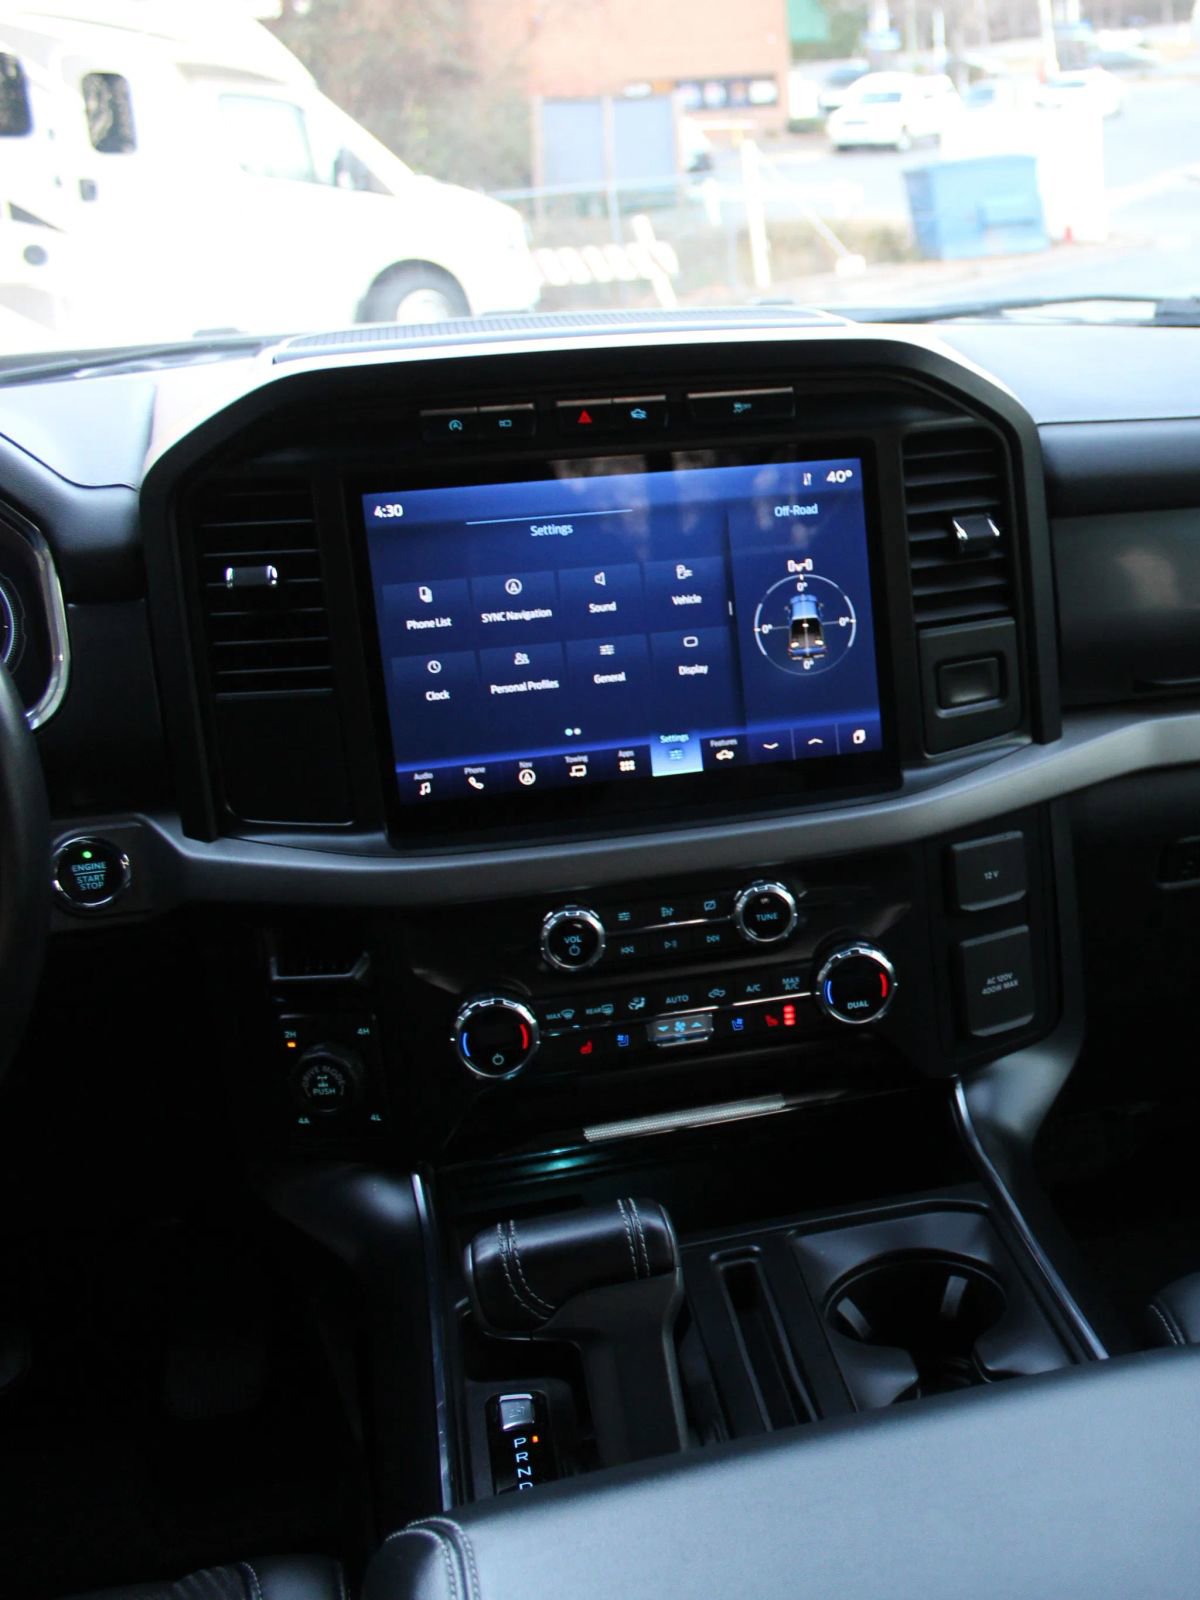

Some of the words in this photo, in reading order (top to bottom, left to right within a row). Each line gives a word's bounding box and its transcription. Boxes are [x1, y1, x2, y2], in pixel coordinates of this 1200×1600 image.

[826, 469, 853, 484] 40°
[373, 504, 404, 518] 4:30
[774, 503, 818, 518] Off-Road
[530, 524, 573, 537] Settings
[672, 594, 702, 606] Vehicle
[589, 602, 617, 613] Sound
[481, 611, 506, 623] SYNC
[506, 608, 552, 621] Navigation
[406, 619, 434, 630] Phone
[435, 617, 452, 627] List
[678, 665, 708, 676] Display
[593, 672, 626, 685] General
[490, 683, 527, 695] Personal
[527, 680, 559, 691] Profiles
[425, 690, 450, 701] Clock
[660, 734, 689, 744] Settings
[710, 739, 738, 748] Features
[464, 767, 486, 775] Phone
[413, 773, 434, 781] Audio
[71, 862, 107, 872] ENGINE
[76, 874, 105, 884] START
[80, 882, 105, 891] STOP
[755, 912, 779, 921] TUNE
[564, 935, 583, 944] VOL
[746, 984, 762, 993] A/C
[665, 995, 690, 1005] AUTO
[847, 1000, 870, 1010] DUAL
[284, 1030, 298, 1039] 2H
[357, 1027, 371, 1036] 4H
[312, 1088, 337, 1096] PUSH
[513, 1437, 527, 1449] P
[515, 1451, 529, 1463] R
[517, 1466, 532, 1478] N
